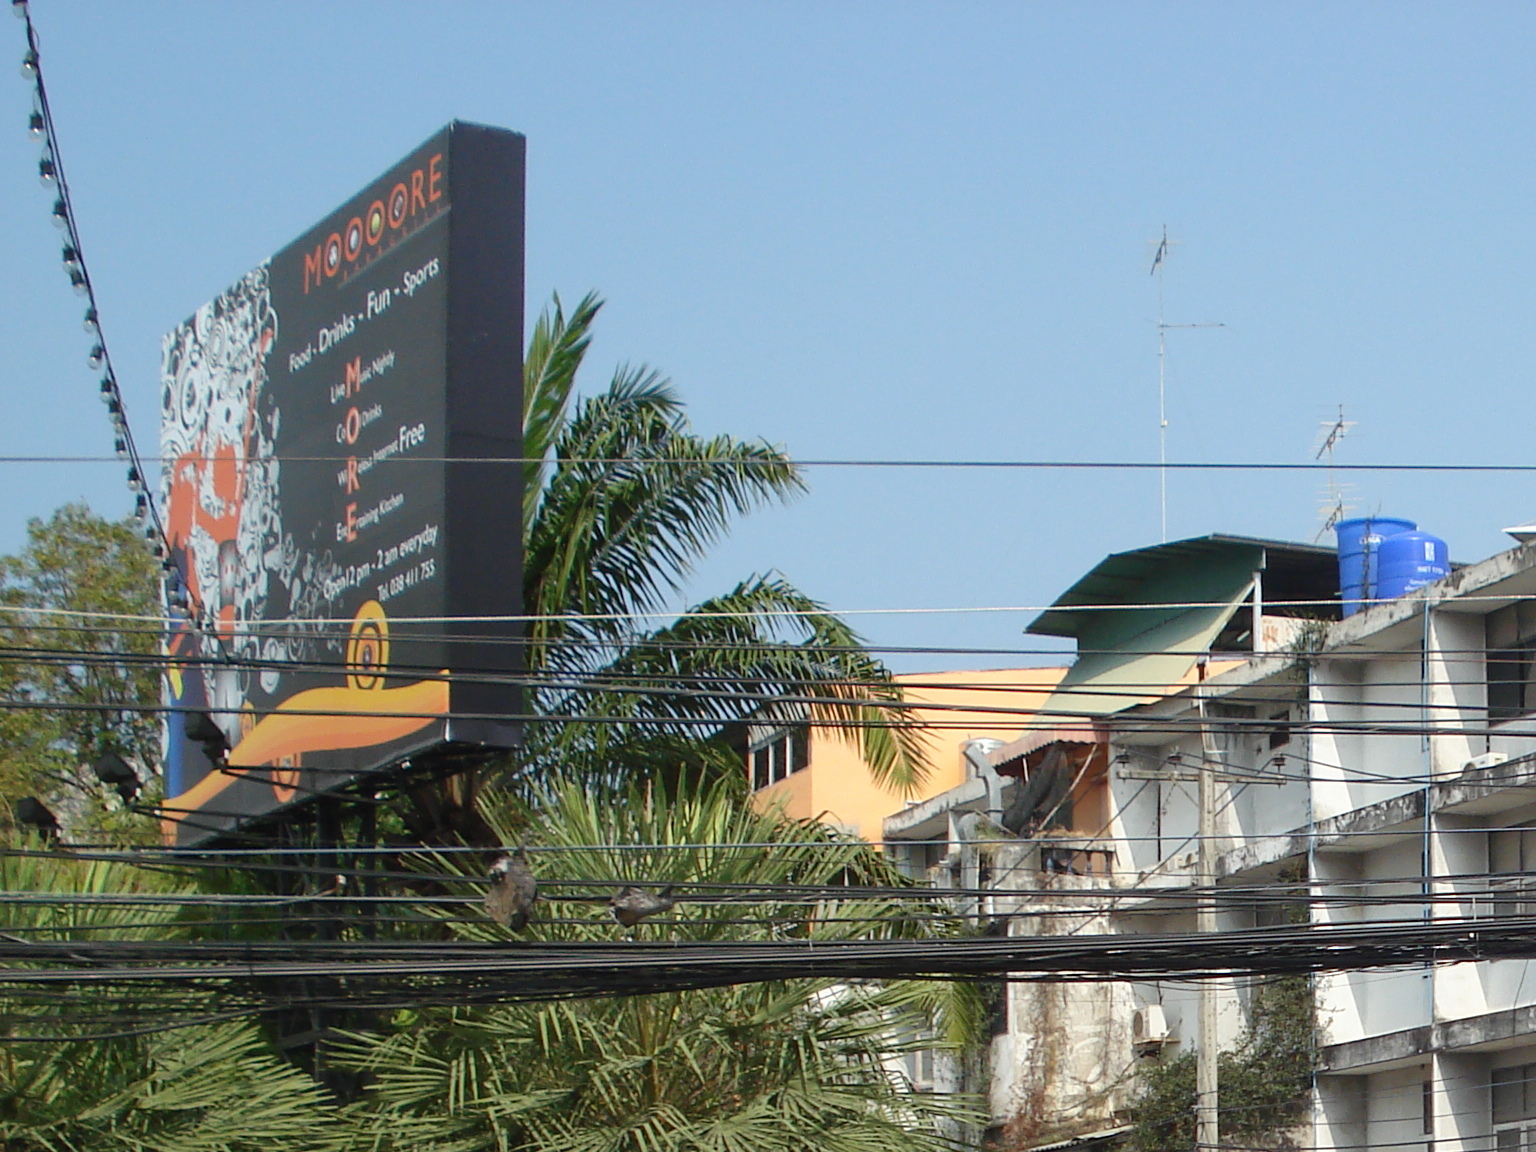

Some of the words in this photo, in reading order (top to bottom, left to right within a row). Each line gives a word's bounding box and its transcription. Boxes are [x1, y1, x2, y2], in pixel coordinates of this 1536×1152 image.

[303, 152, 442, 295] MOOOORE
[288, 343, 312, 373] Food
[318, 313, 356, 355] Drinks
[367, 288, 391, 320] Fun
[402, 257, 440, 298] Sports
[330, 383, 346, 404] Live
[399, 422, 426, 453] Free
[356, 562, 371, 588] pm
[376, 548, 384, 570] 2
[384, 545, 399, 566] am
[399, 524, 438, 558] everyday
